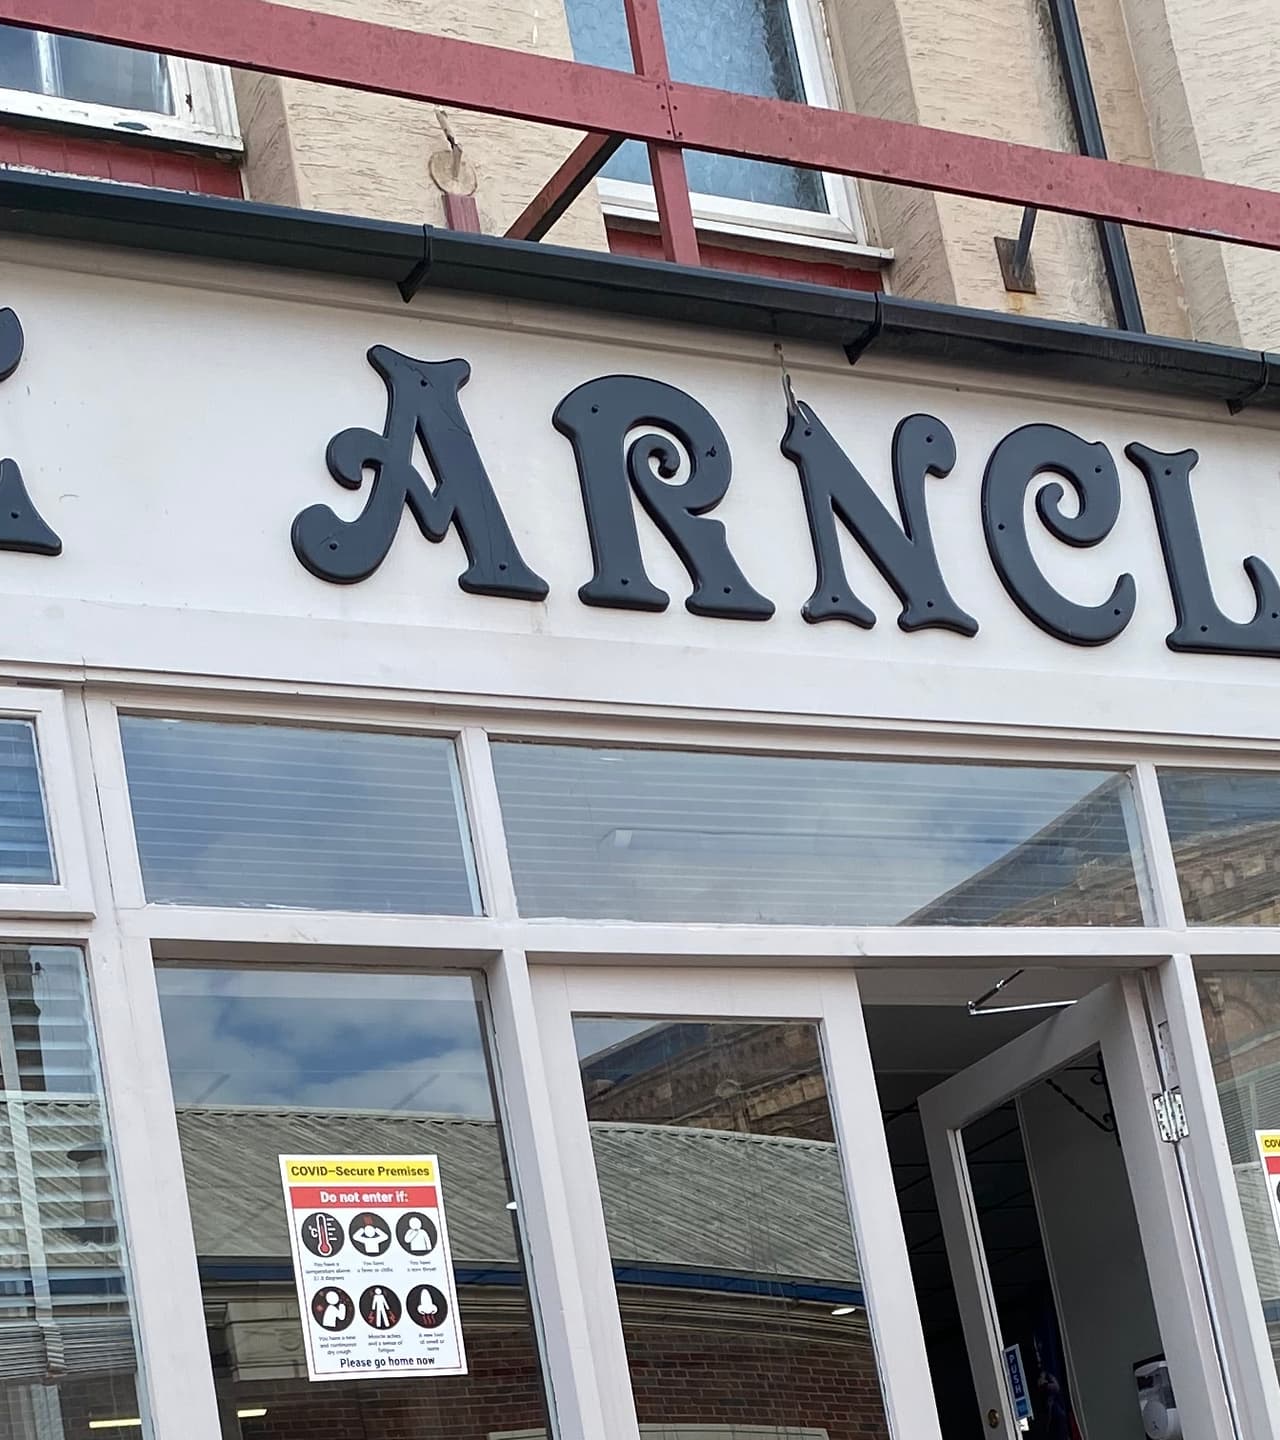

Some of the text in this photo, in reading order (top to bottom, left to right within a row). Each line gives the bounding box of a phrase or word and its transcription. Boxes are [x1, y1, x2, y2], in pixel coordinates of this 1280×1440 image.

[377, 1165, 430, 1177] Premises
[320, 1189, 409, 1204] Do not enter if:
[340, 1356, 435, 1369] Please go home now
[1008, 1353, 1022, 1394] PUSH
